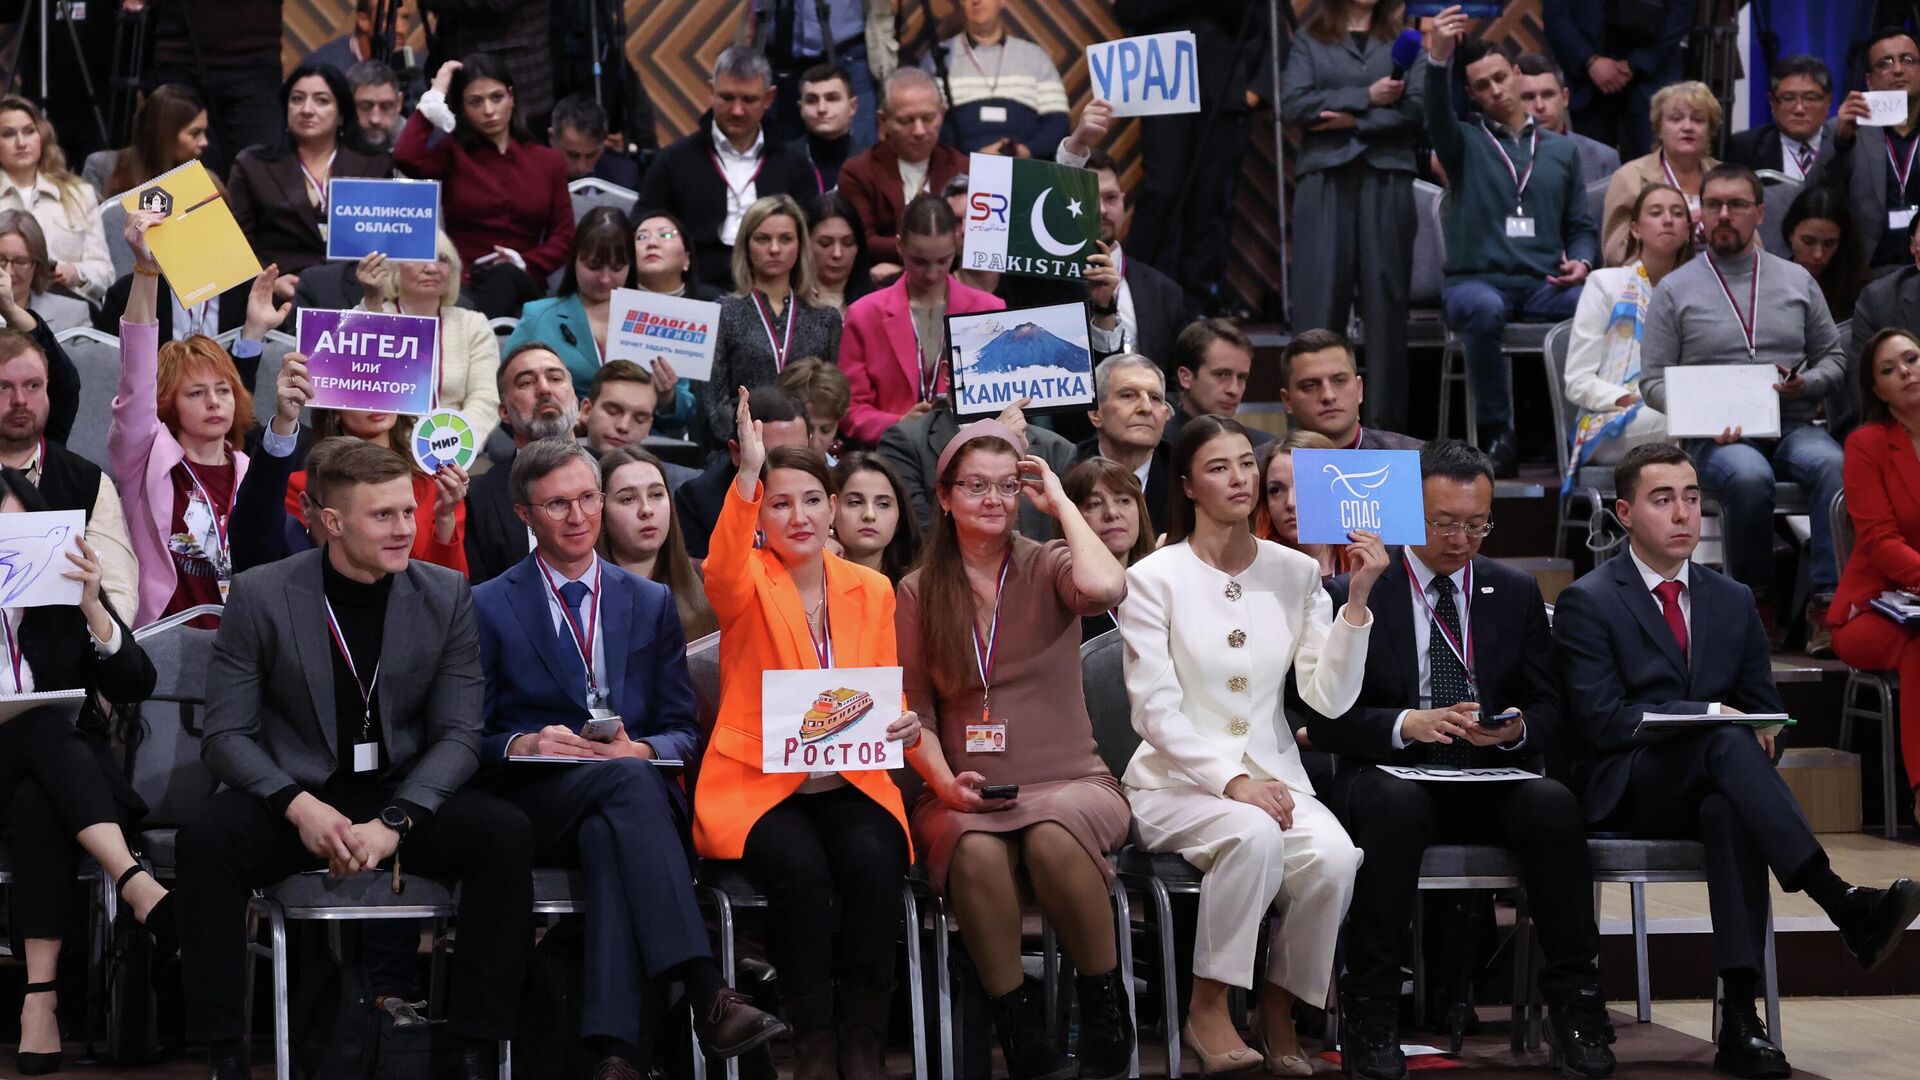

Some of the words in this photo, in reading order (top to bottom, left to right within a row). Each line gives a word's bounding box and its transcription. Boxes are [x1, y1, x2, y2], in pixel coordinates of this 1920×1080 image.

[1091, 38, 1195, 104] УРАЛ
[335, 205, 432, 218] САХАЛИНСКАЯ
[970, 192, 1008, 223] SR
[355, 222, 413, 234] ОБЛАСТЬ
[646, 326, 703, 343] РЕГИОН
[314, 330, 419, 360] АНГЕЛ
[351, 361, 381, 374] ИЛИ
[312, 376, 417, 395] ТЕРМИНАТОР?
[962, 376, 1087, 405] КАМЧАТКА
[431, 436, 459, 450] МИР
[1340, 500, 1381, 529] СПАС
